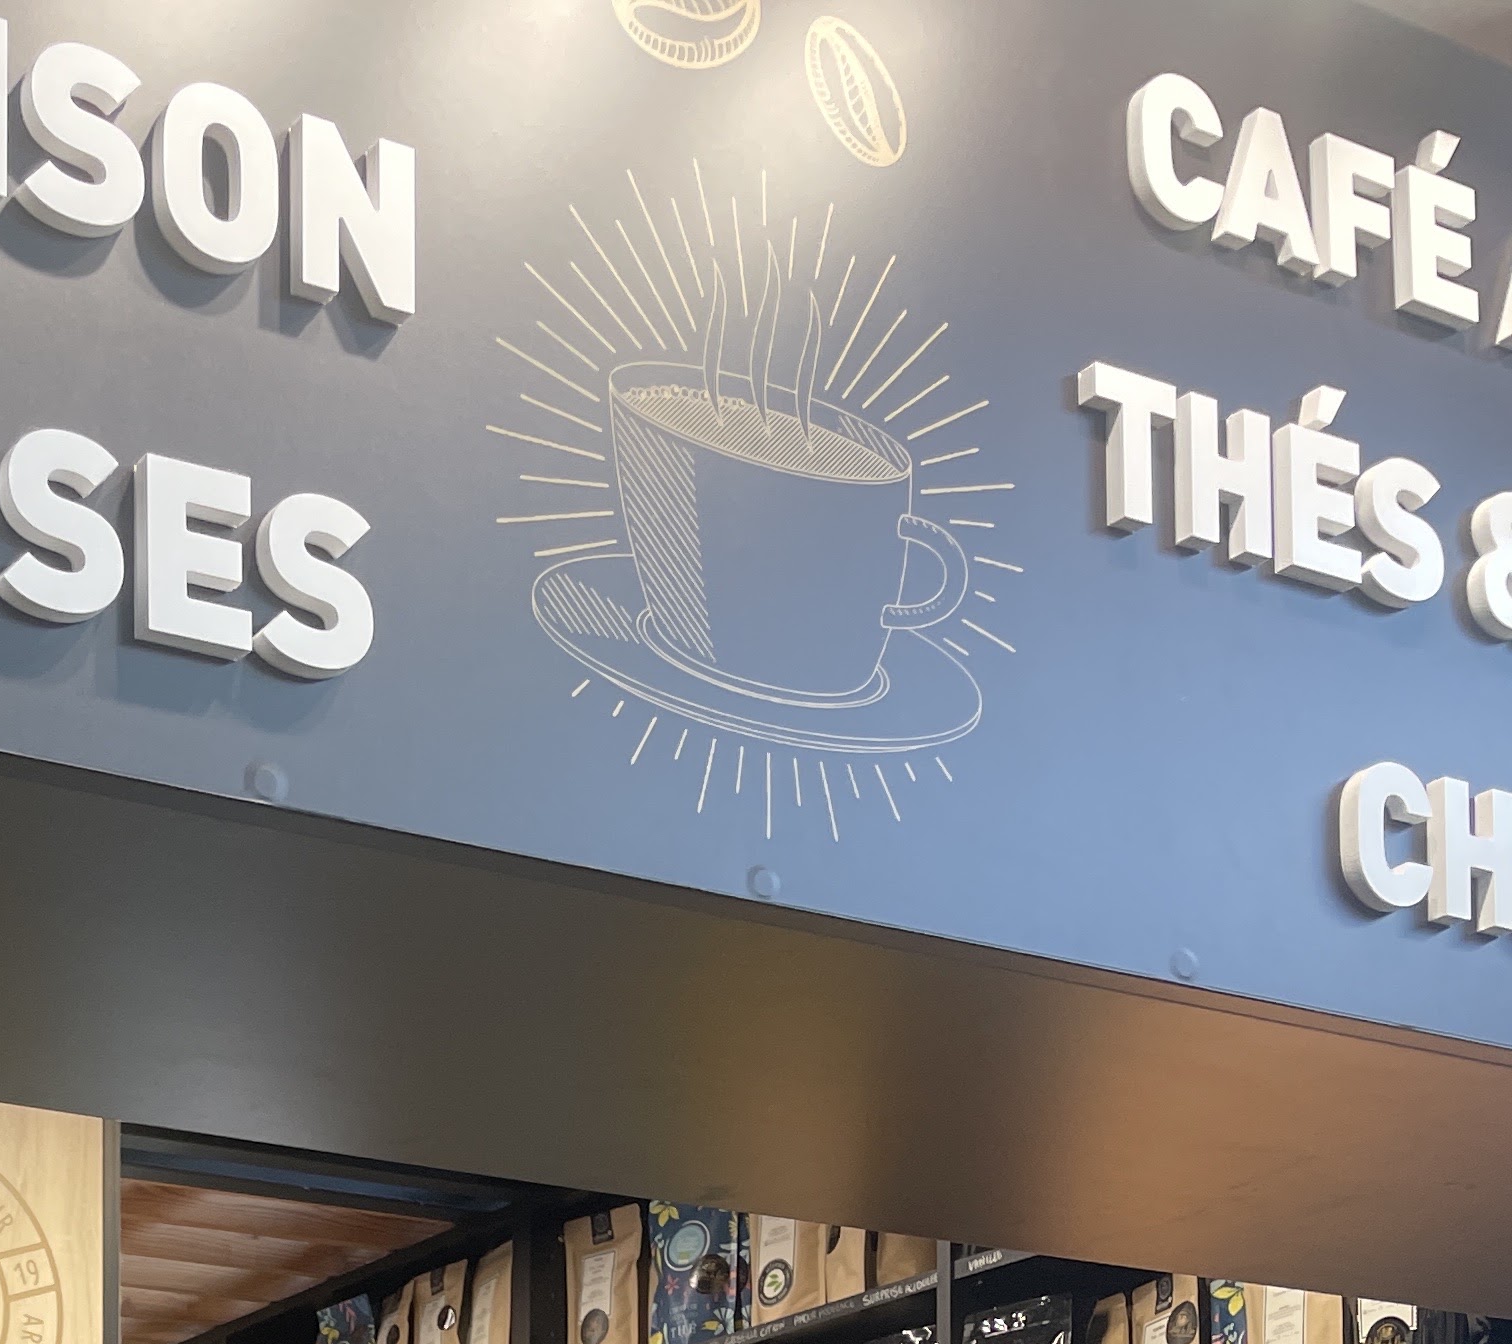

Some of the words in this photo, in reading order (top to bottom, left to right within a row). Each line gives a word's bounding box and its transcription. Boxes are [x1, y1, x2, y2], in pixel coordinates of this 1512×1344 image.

[1126, 72, 1480, 329] CAFÉ
[1077, 360, 1446, 610] THÉS
[13, 1259, 40, 1286] 19
